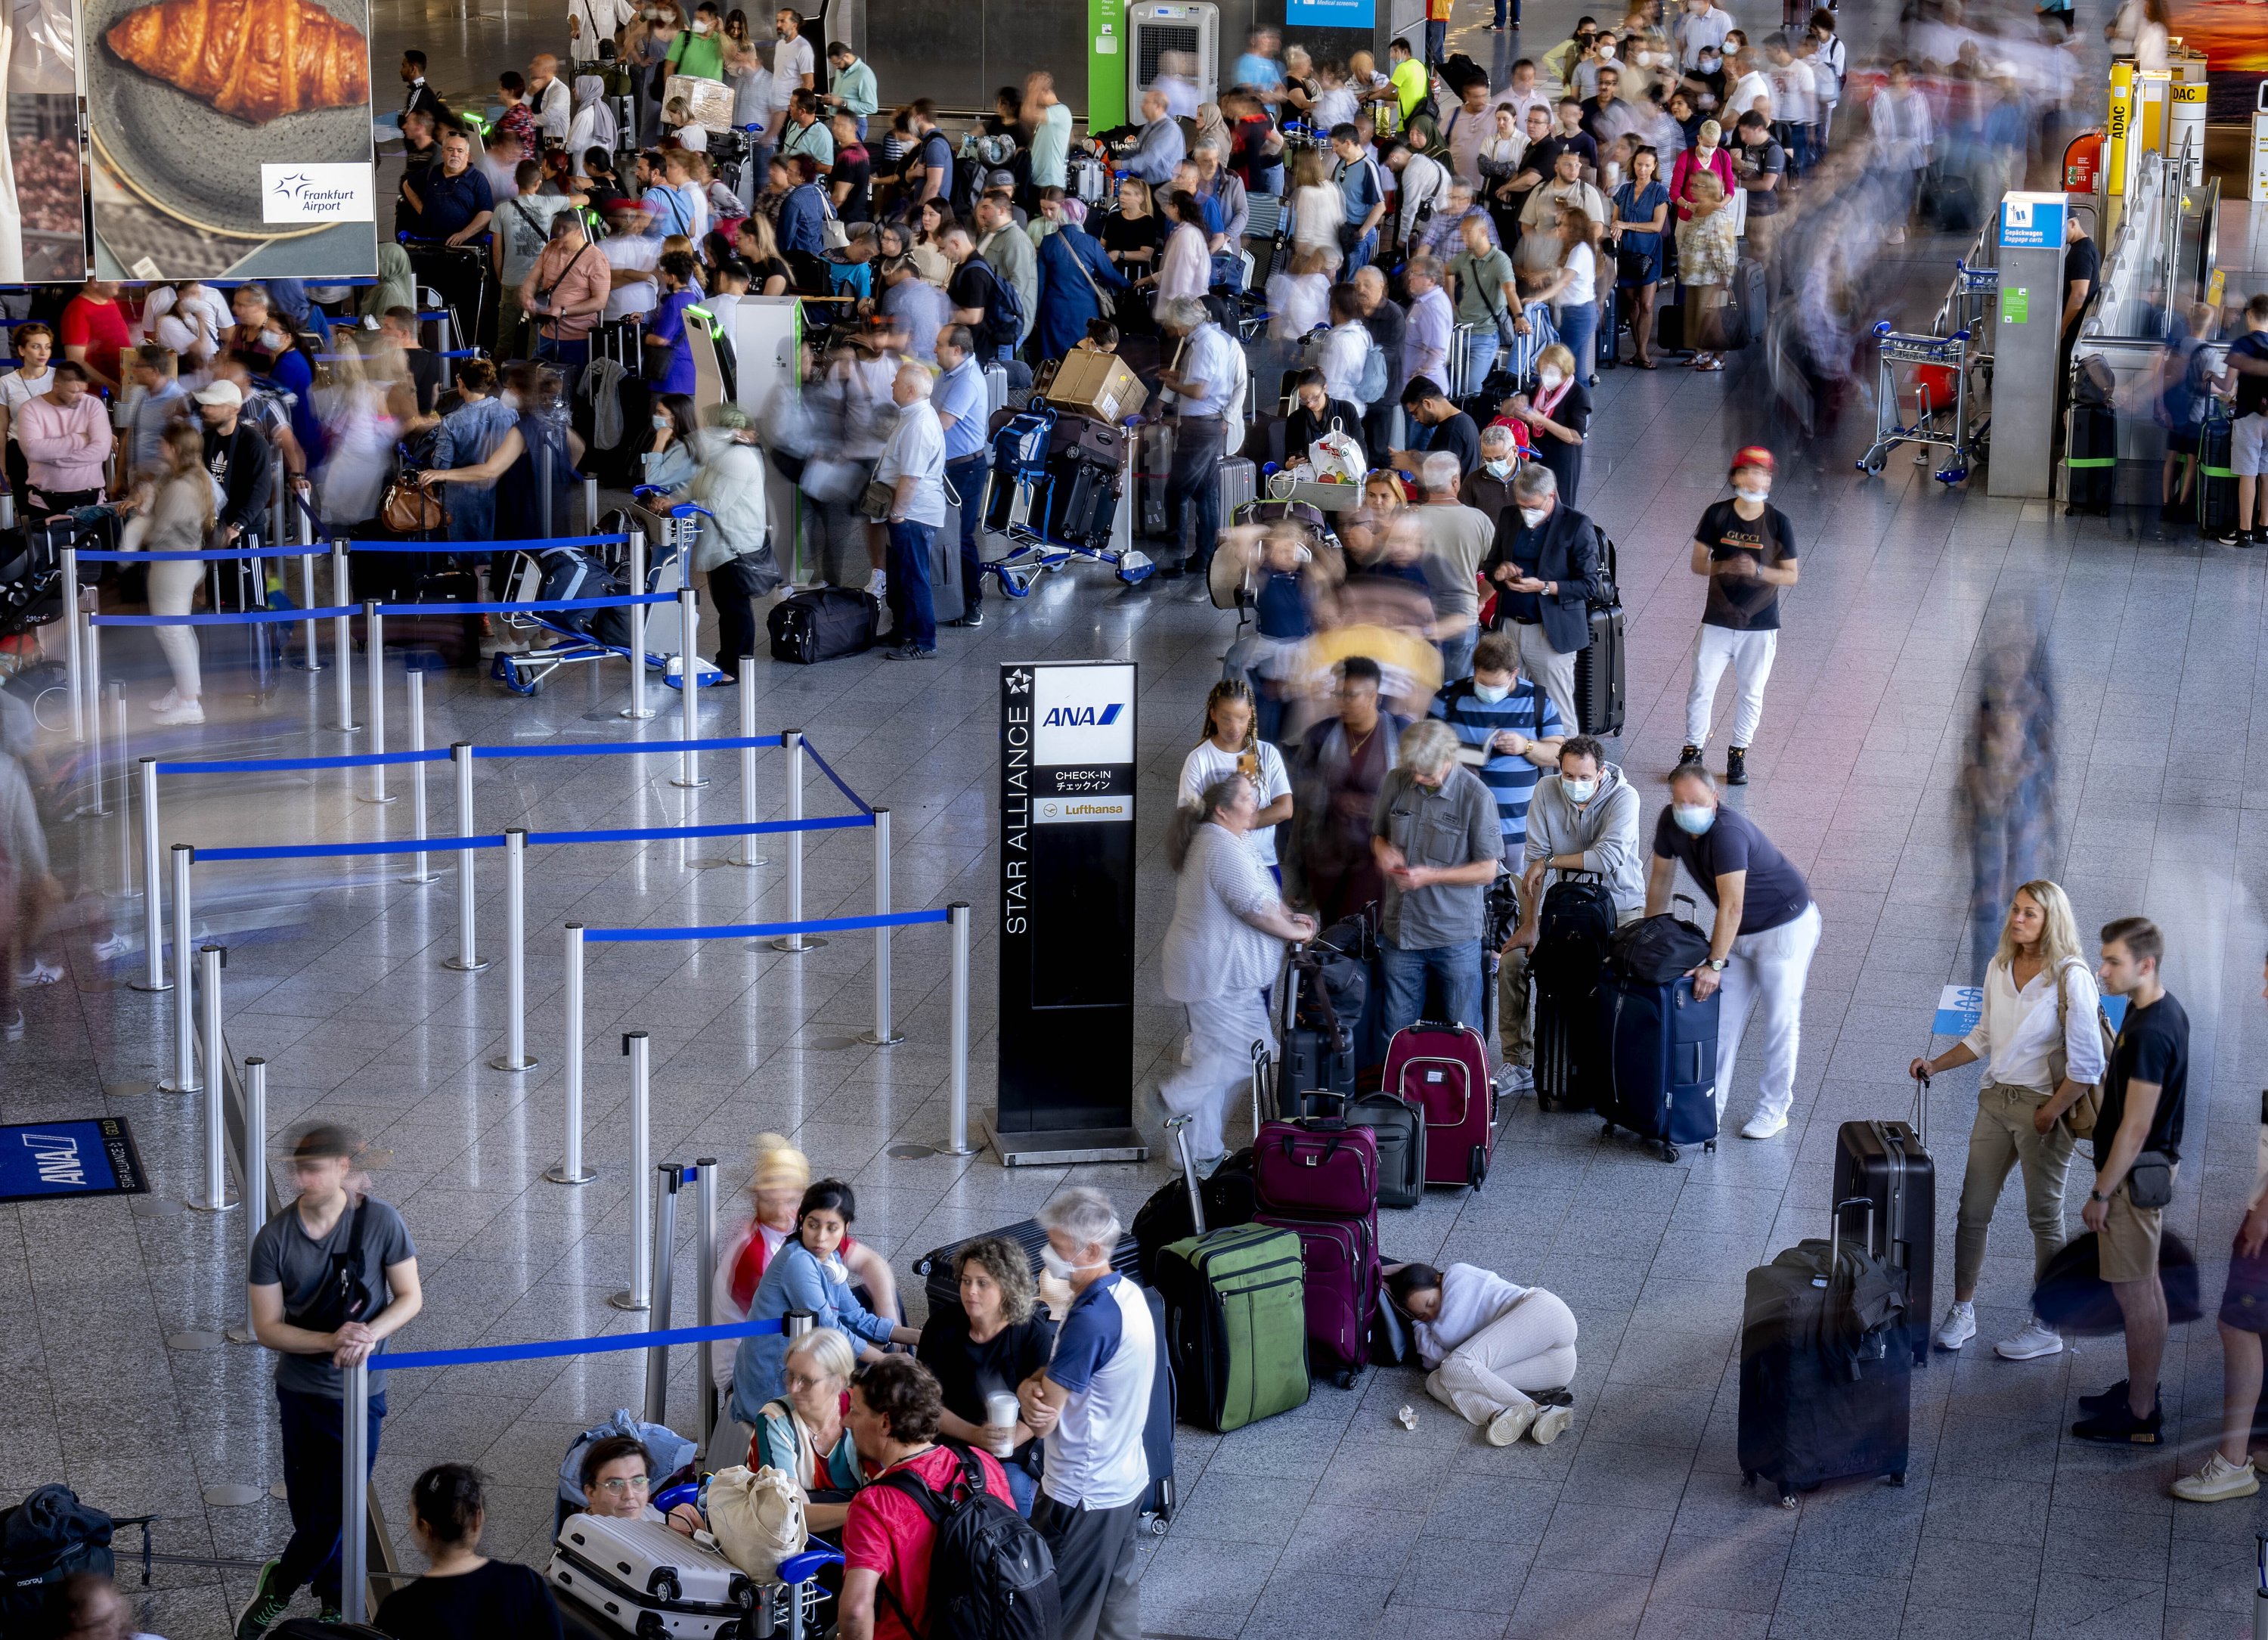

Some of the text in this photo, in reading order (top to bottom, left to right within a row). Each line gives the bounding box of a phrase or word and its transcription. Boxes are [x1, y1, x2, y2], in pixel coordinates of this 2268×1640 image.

[2112, 106, 2125, 139] ADAC
[304, 190, 354, 200] Frankfurt
[302, 201, 340, 213] Airport
[1727, 530, 1760, 542] GUCCI
[1043, 707, 1095, 727] ANA
[1055, 770, 1111, 780] CHECK-IN
[1056, 781, 1110, 791] チェックイン
[1065, 804, 1123, 815] Lufthansa
[1007, 707, 1028, 934] STAR ALLIANCE
[103, 1121, 136, 1188] STAR ALLIANCE GOLD
[35, 1150, 87, 1185] ANA
[17, 1576, 43, 1587] osprey
